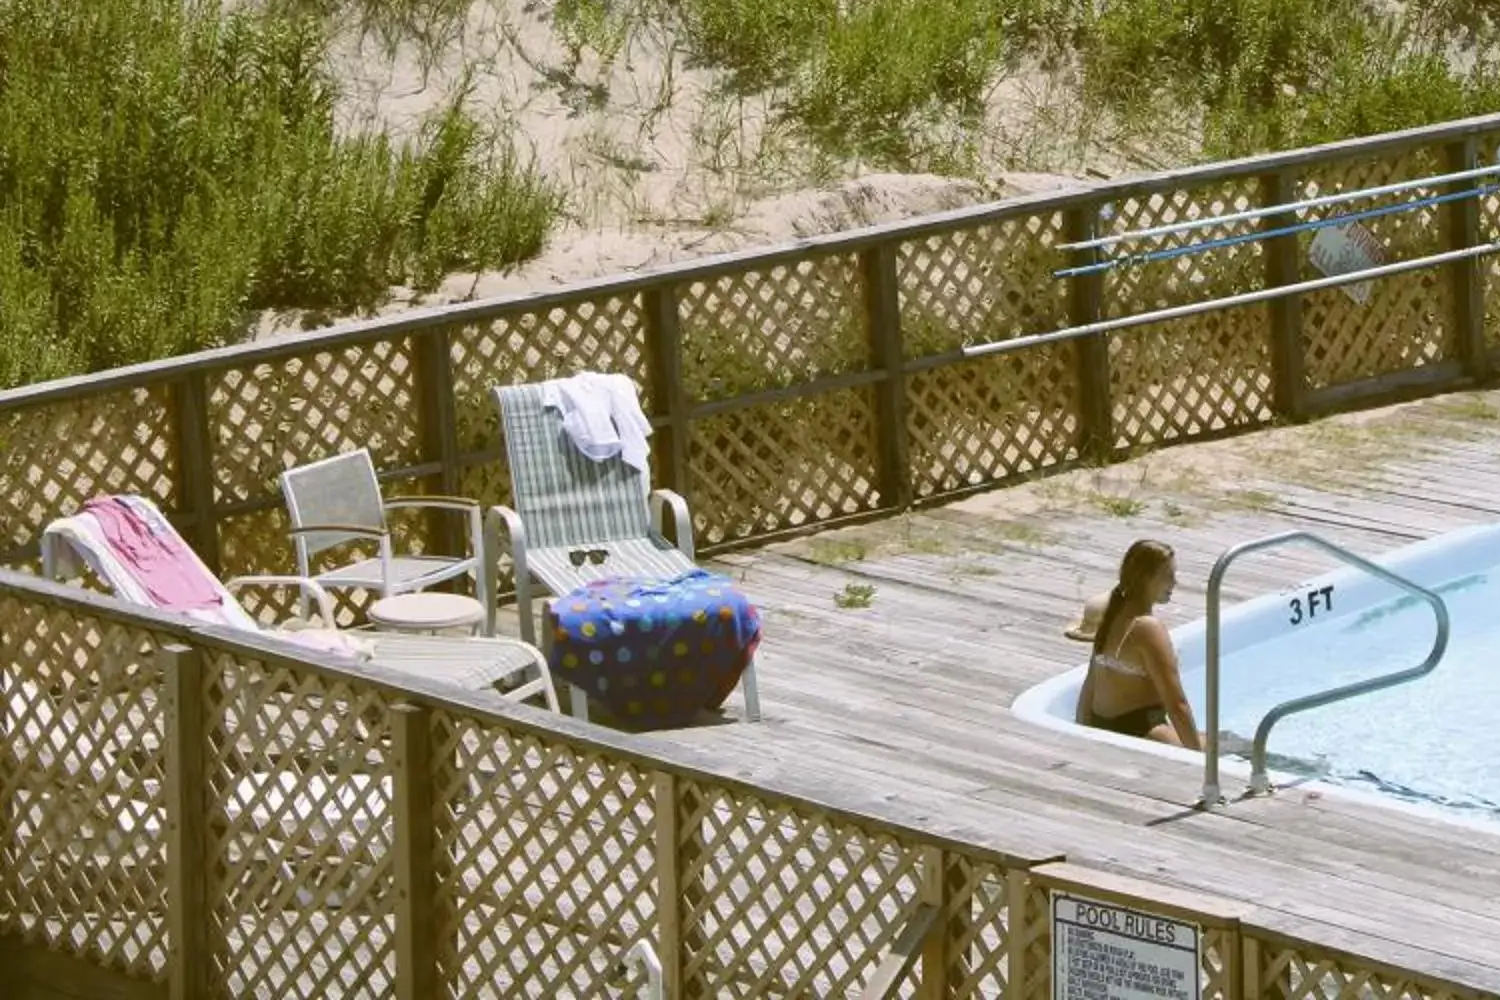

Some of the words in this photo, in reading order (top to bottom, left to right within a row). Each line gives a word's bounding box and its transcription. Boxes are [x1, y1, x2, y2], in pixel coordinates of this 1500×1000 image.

[1289, 597, 1303, 625] 3
[1308, 584, 1334, 618] FT
[1076, 903, 1121, 931] POOL
[1125, 914, 1176, 943] RULES
